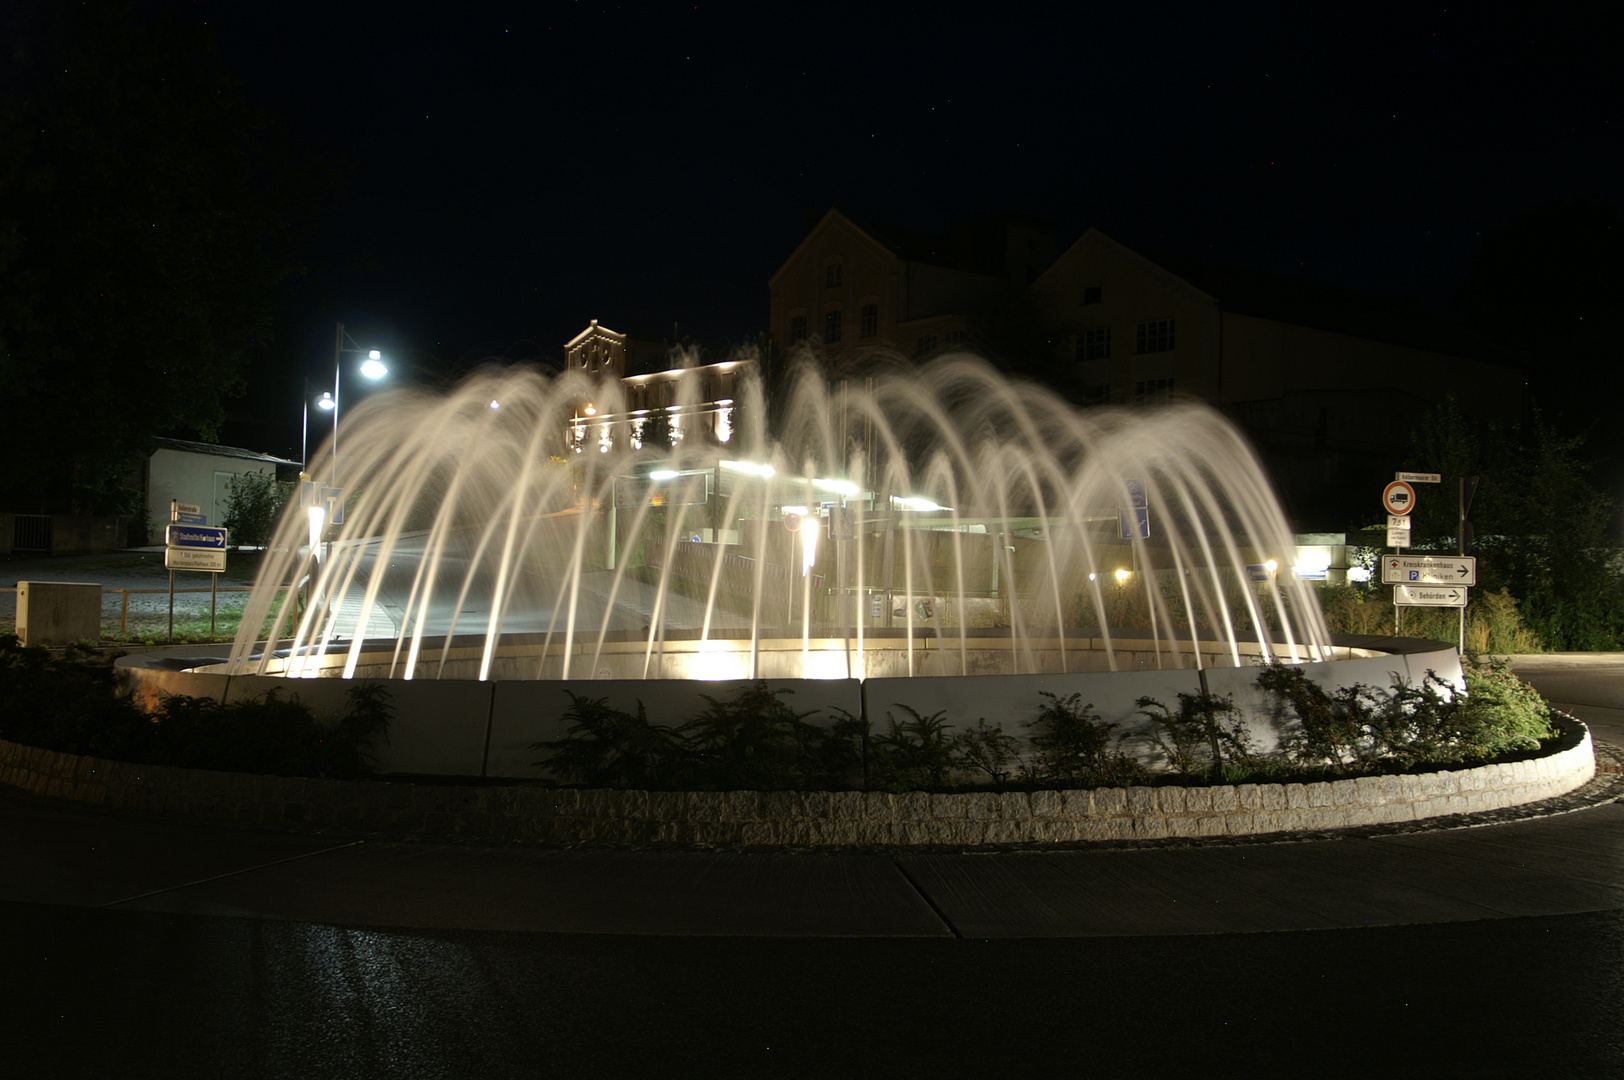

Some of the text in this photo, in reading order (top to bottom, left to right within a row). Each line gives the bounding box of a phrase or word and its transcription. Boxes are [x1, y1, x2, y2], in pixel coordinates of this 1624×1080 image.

[1402, 560, 1454, 569] Kreiskrankenhaus
[1422, 572, 1454, 580] Kliniken
[1419, 591, 1446, 600] Behörden
